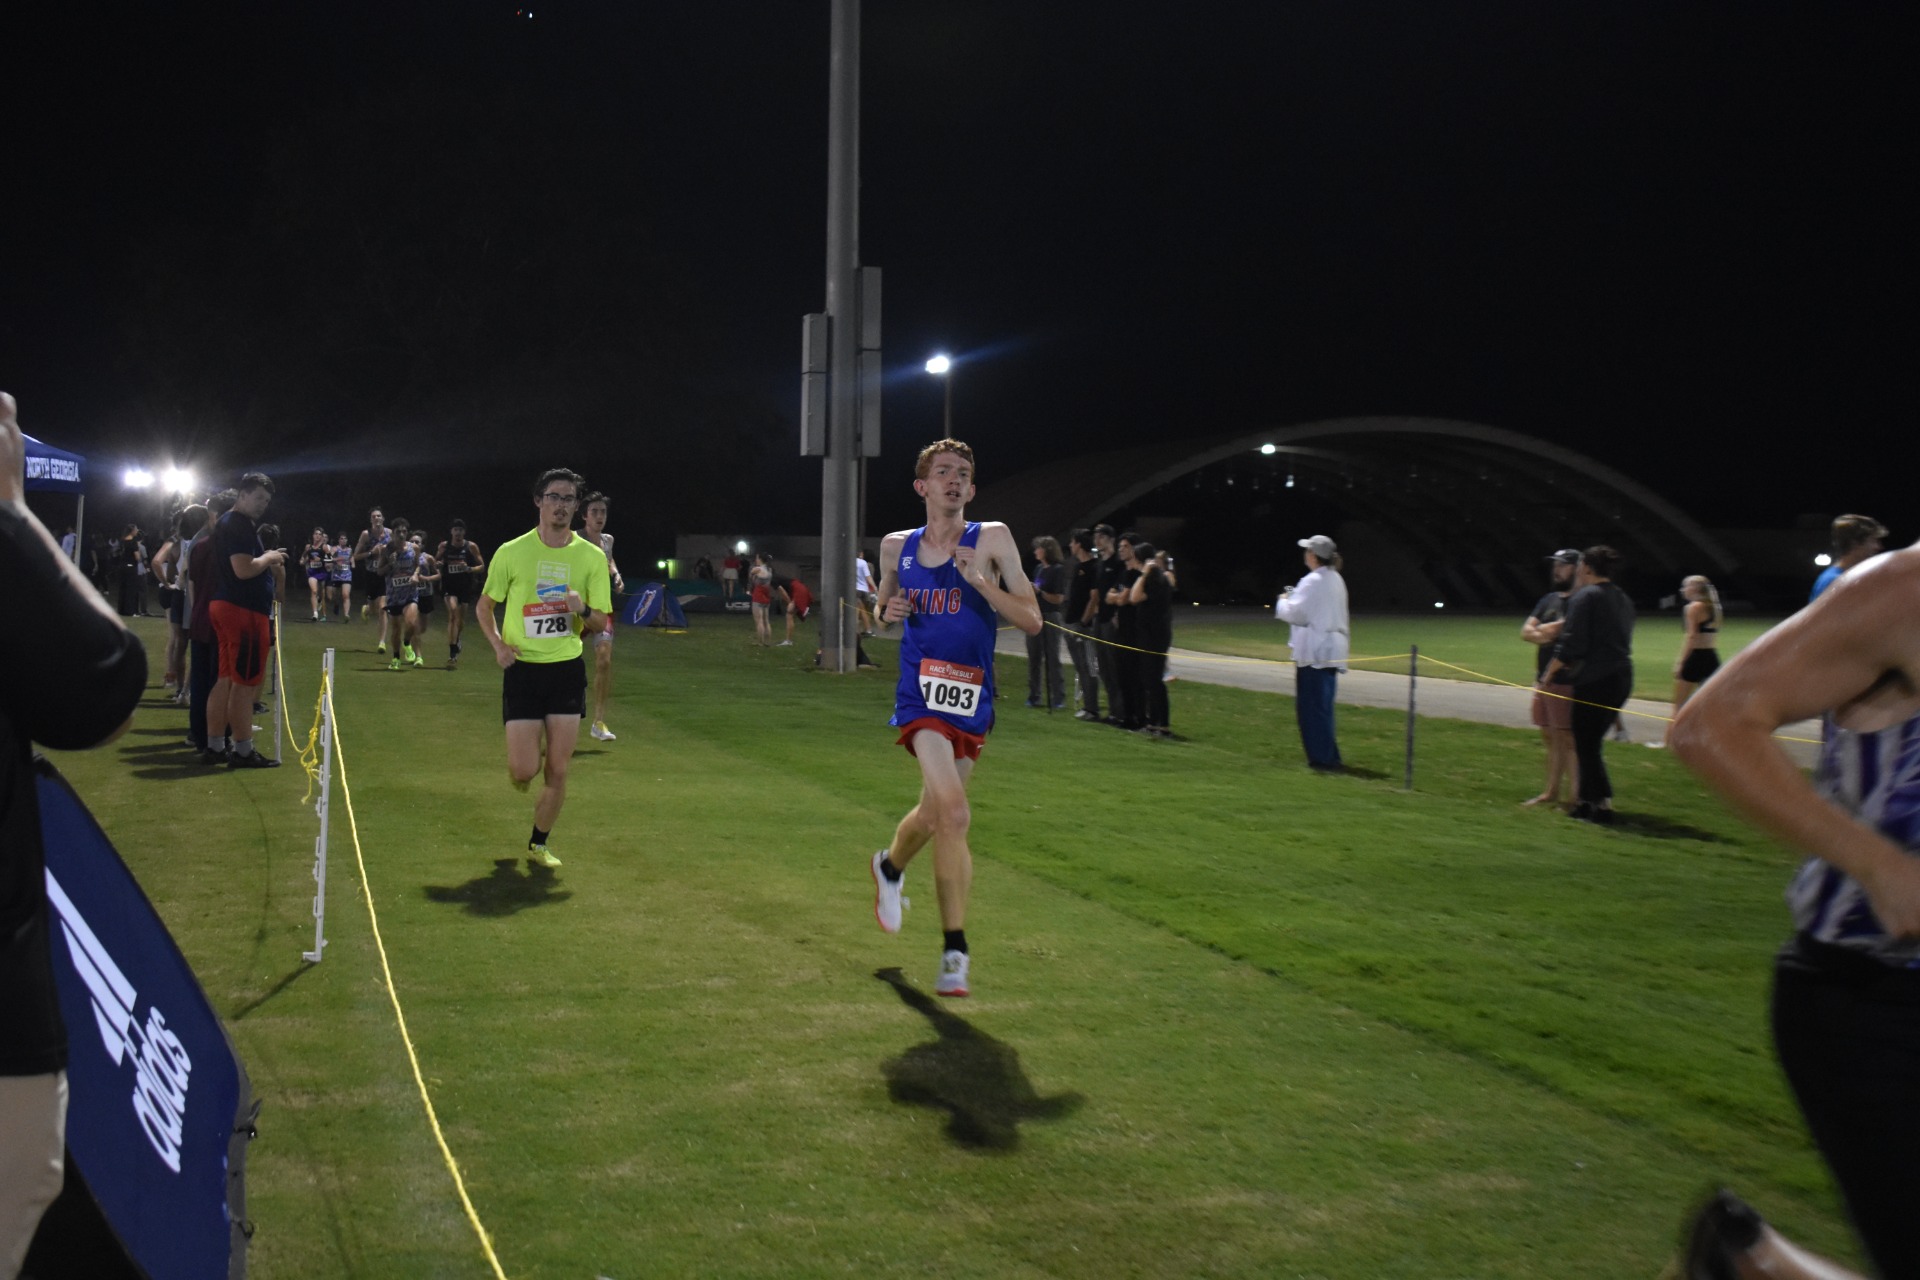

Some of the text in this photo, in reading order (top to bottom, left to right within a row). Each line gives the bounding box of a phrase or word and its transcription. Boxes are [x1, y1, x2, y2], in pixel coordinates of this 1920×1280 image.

[26, 456, 81, 482] NORTH GEORGIA
[908, 588, 962, 615] KING
[533, 616, 567, 635] 728
[929, 665, 946, 674] RACE
[952, 669, 974, 679] RESULT
[922, 681, 975, 710] 1093
[125, 1006, 192, 1174] adidas
